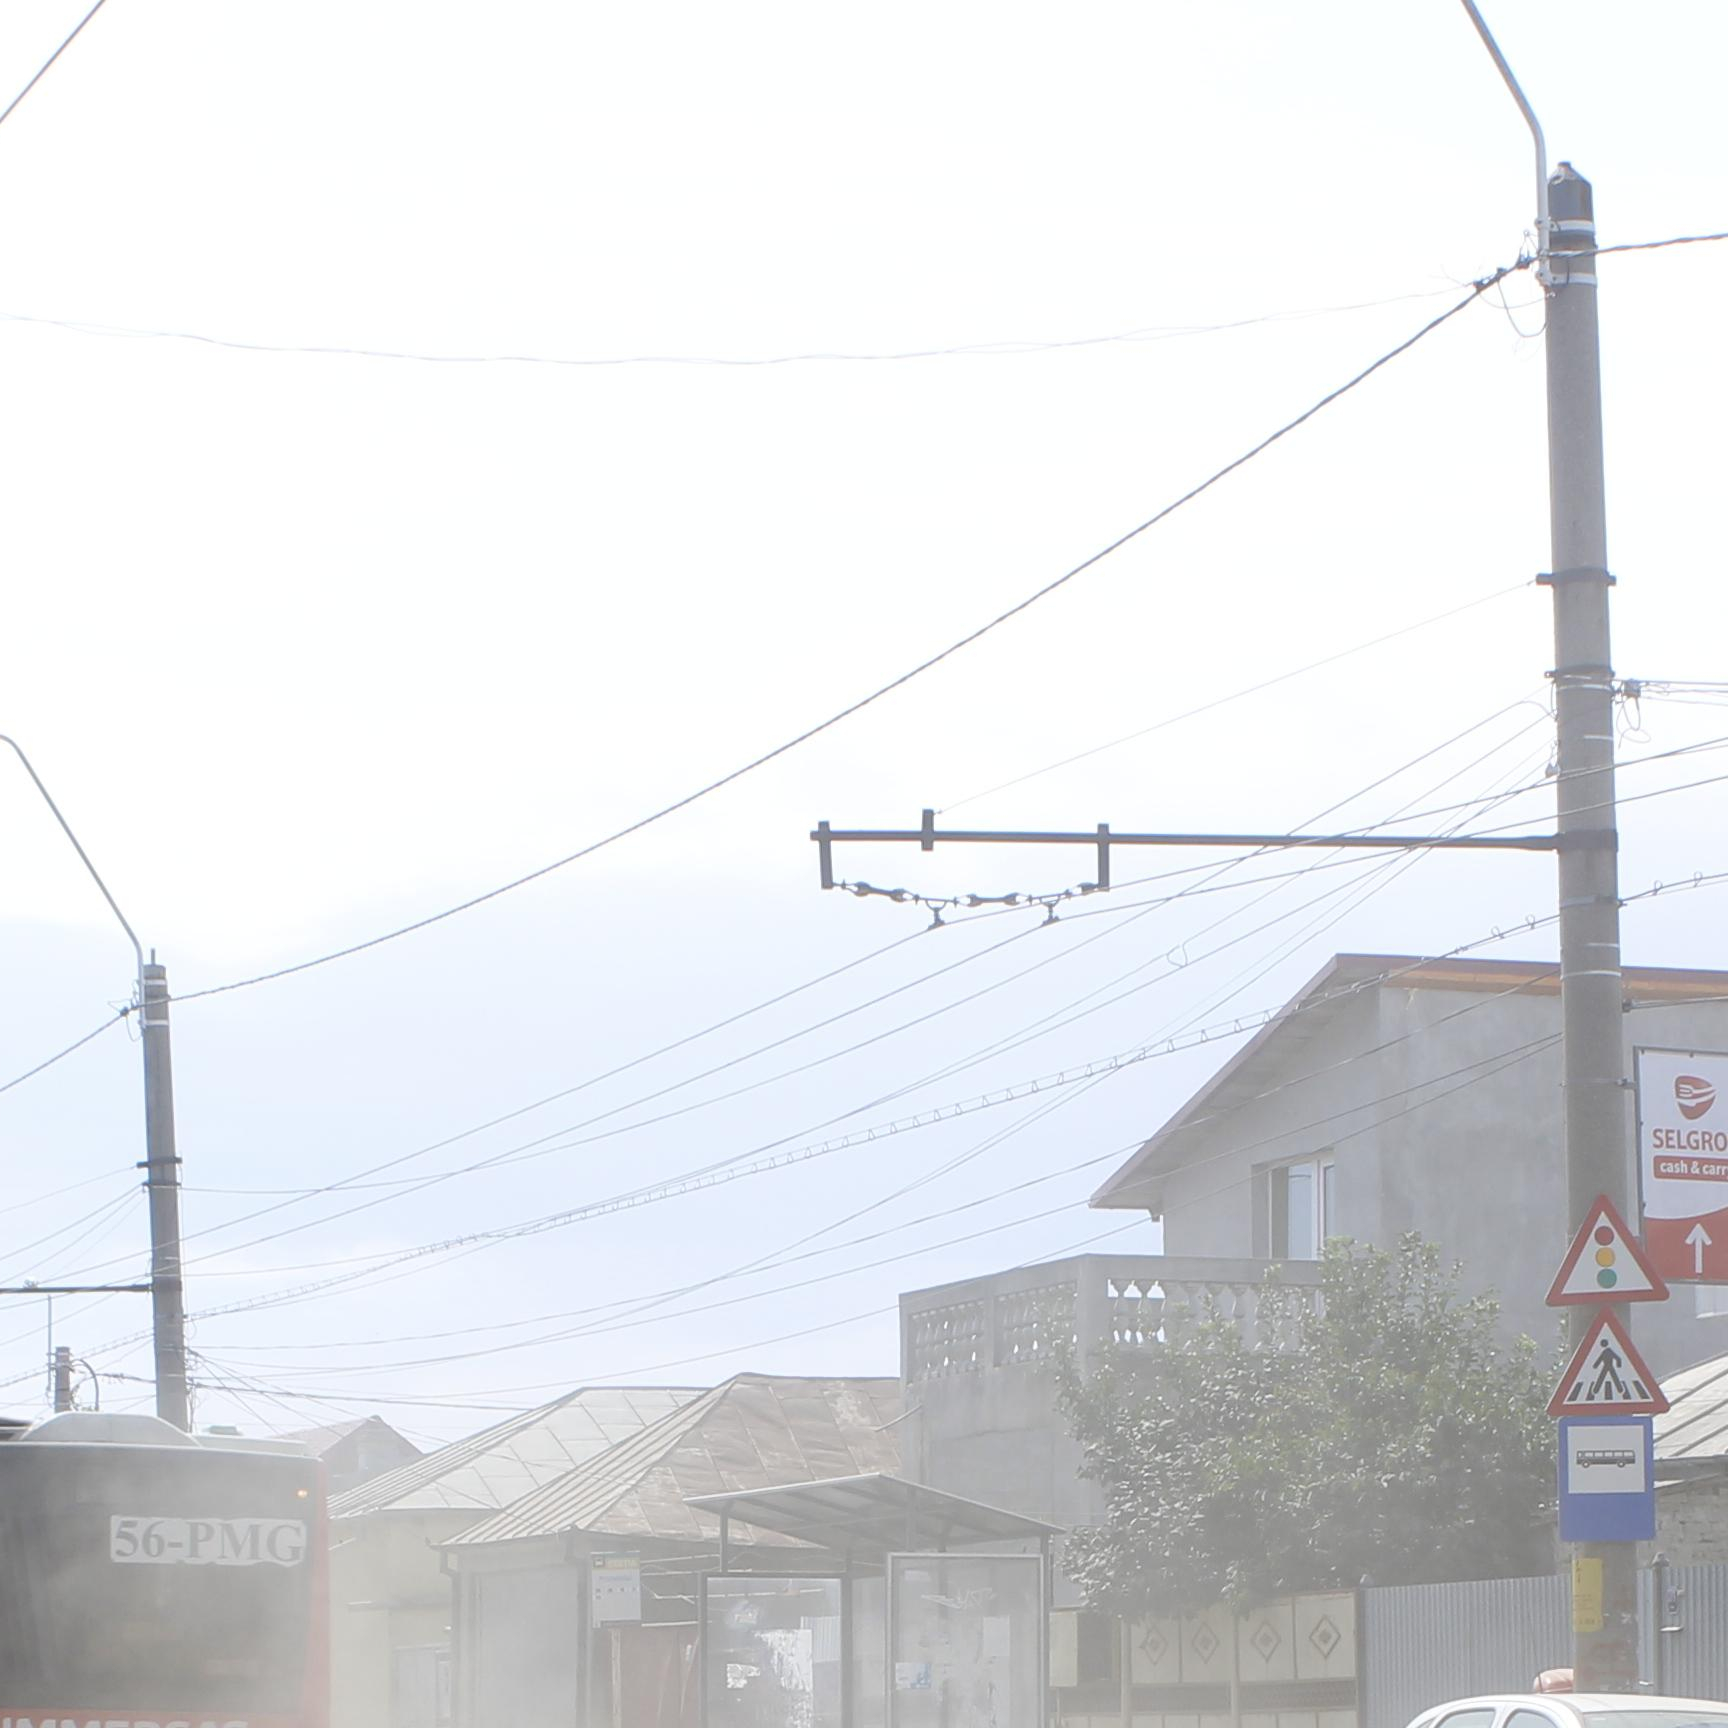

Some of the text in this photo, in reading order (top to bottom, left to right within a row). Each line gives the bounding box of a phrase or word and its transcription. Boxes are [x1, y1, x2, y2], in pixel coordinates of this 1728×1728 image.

[1660, 1160, 1688, 1174] cash
[1691, 1161, 1700, 1174] &
[115, 1520, 304, 1562] 56-PMG
